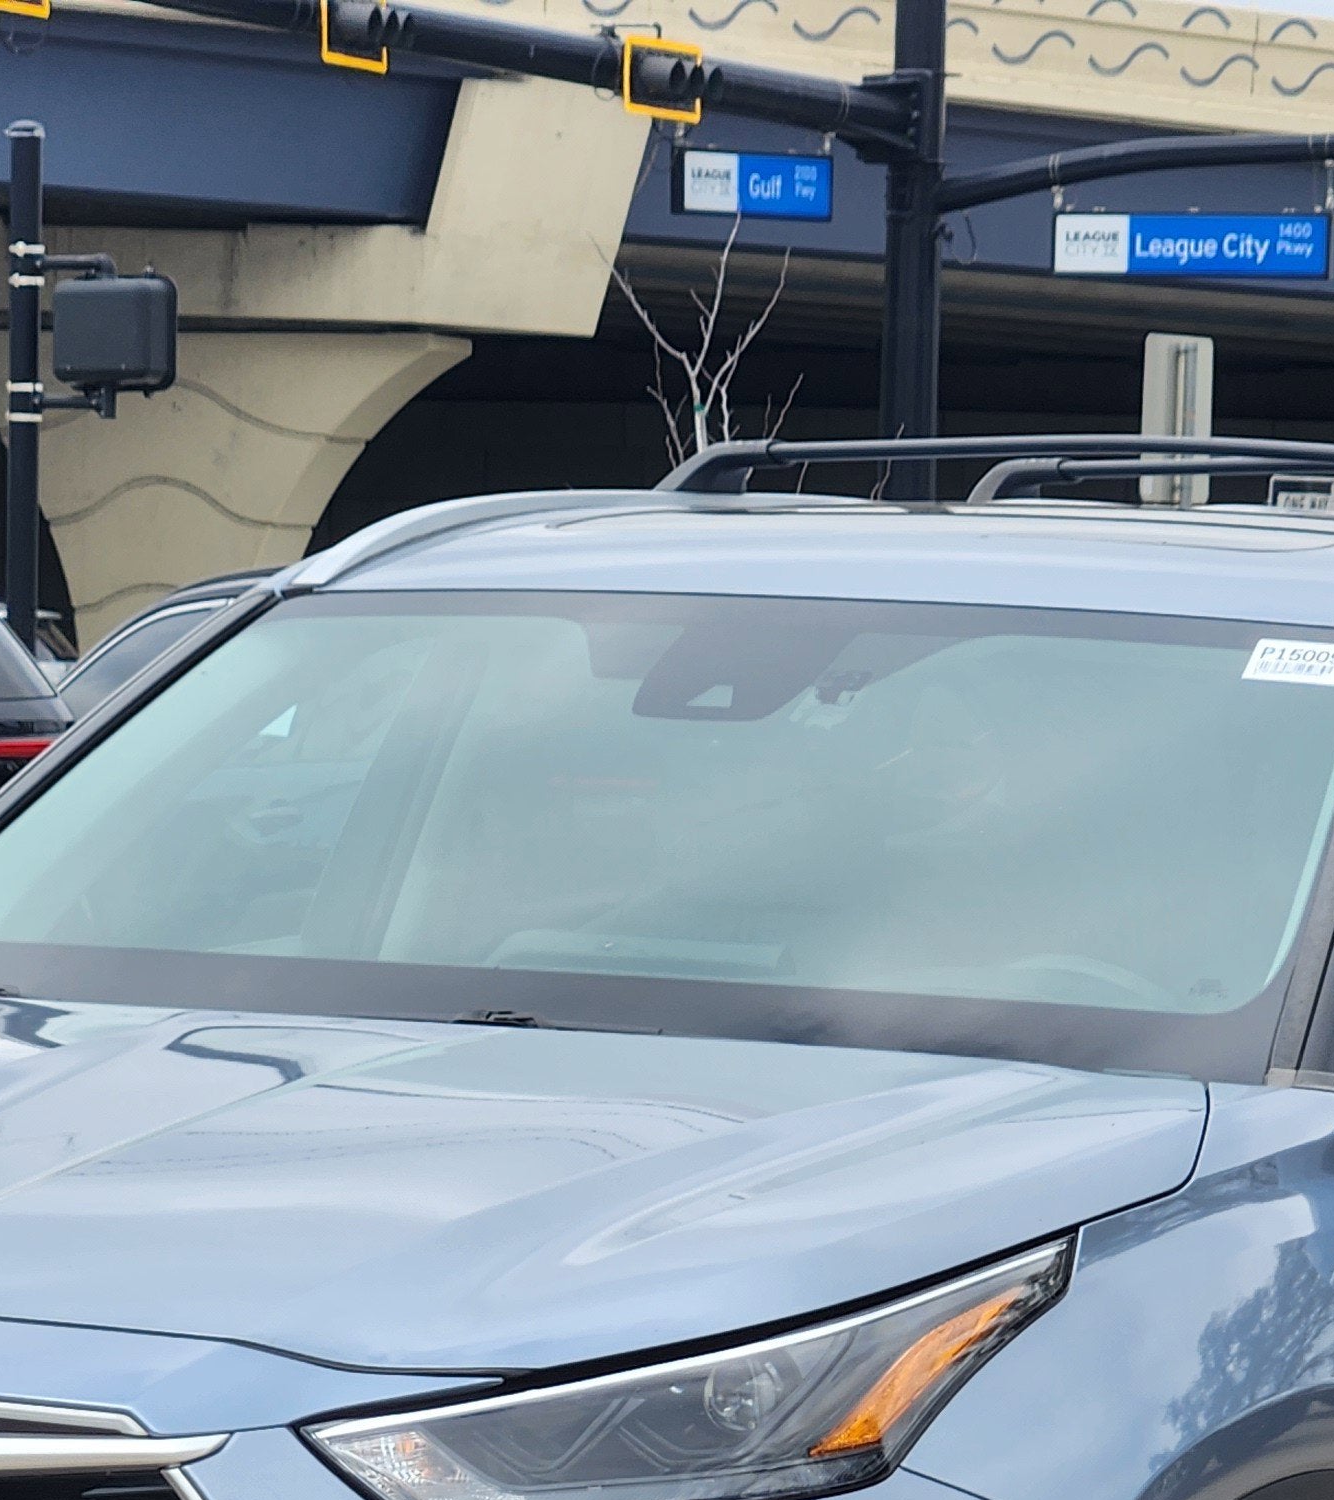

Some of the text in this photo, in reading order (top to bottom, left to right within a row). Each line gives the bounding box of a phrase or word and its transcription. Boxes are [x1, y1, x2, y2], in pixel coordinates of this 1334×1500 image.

[690, 167, 732, 181] LEAGUE
[748, 172, 783, 200] Gulf
[1065, 229, 1120, 242] LEAGUE
[1278, 222, 1313, 239] 1400
[1134, 231, 1271, 267] League City
[1275, 239, 1315, 259] Pkwy
